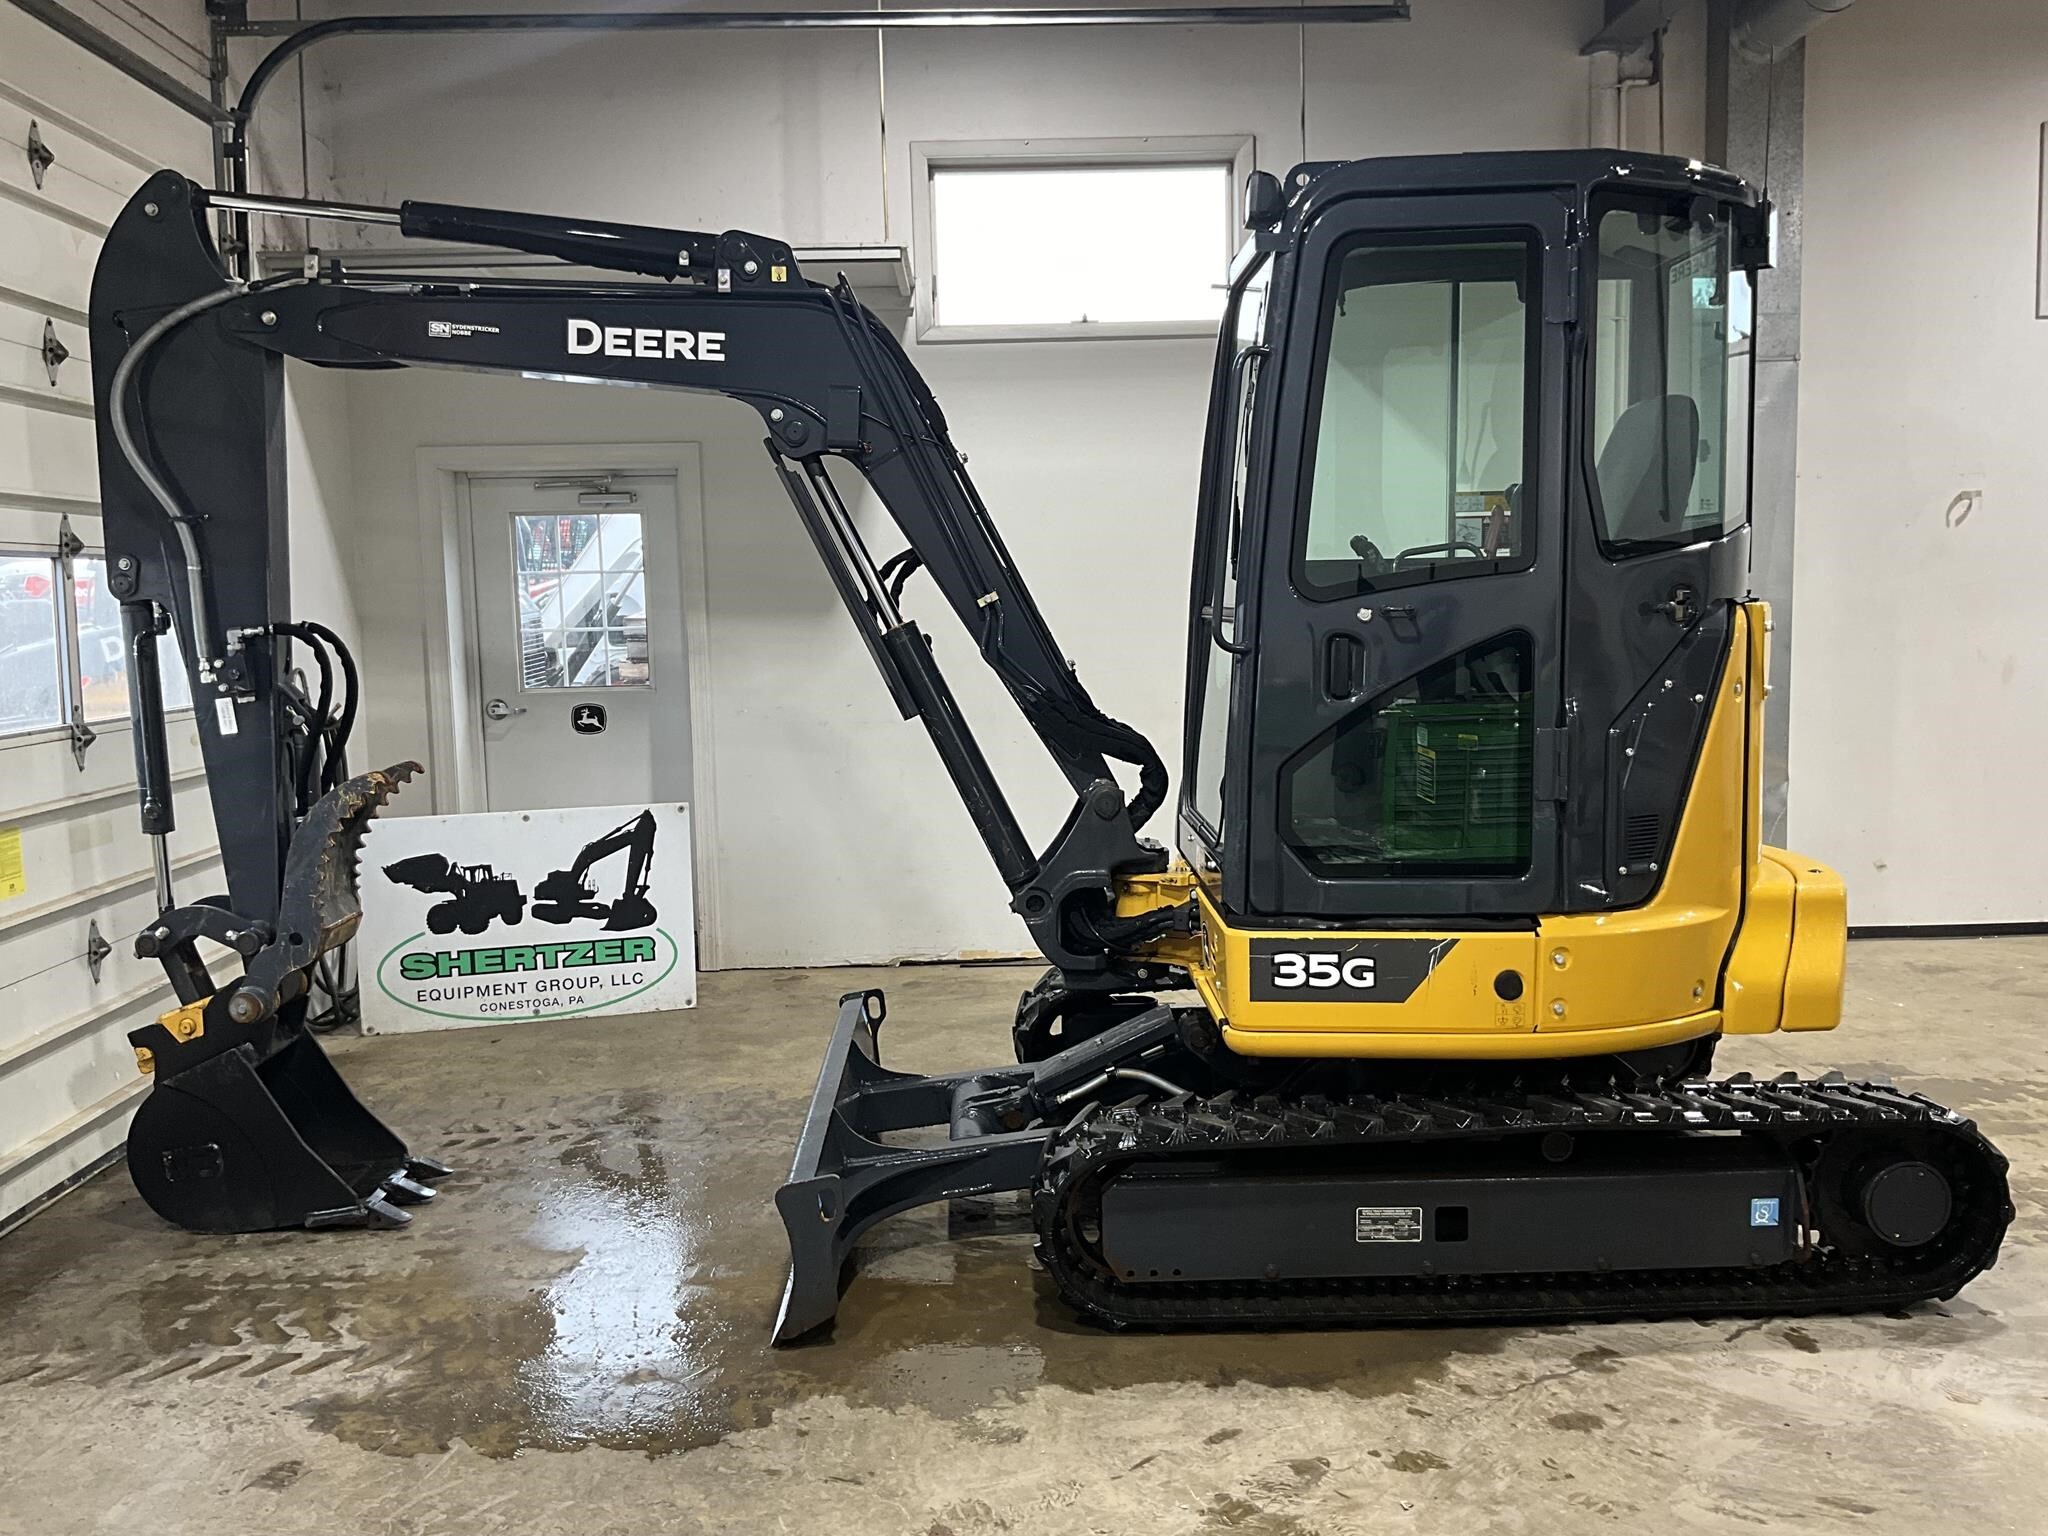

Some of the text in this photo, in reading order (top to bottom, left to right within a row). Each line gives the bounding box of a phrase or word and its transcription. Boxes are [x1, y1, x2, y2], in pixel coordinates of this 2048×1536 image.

[430, 323, 450, 333] SN
[452, 324, 500, 333] SYDENSTRICKER
[568, 319, 725, 361] DEERE
[400, 936, 656, 980] SHERTZER
[1273, 952, 1375, 988] 35G
[417, 972, 645, 1002] EQUIPMENT GROUP, LLC
[480, 996, 585, 1013] CONESTOGA, PA
